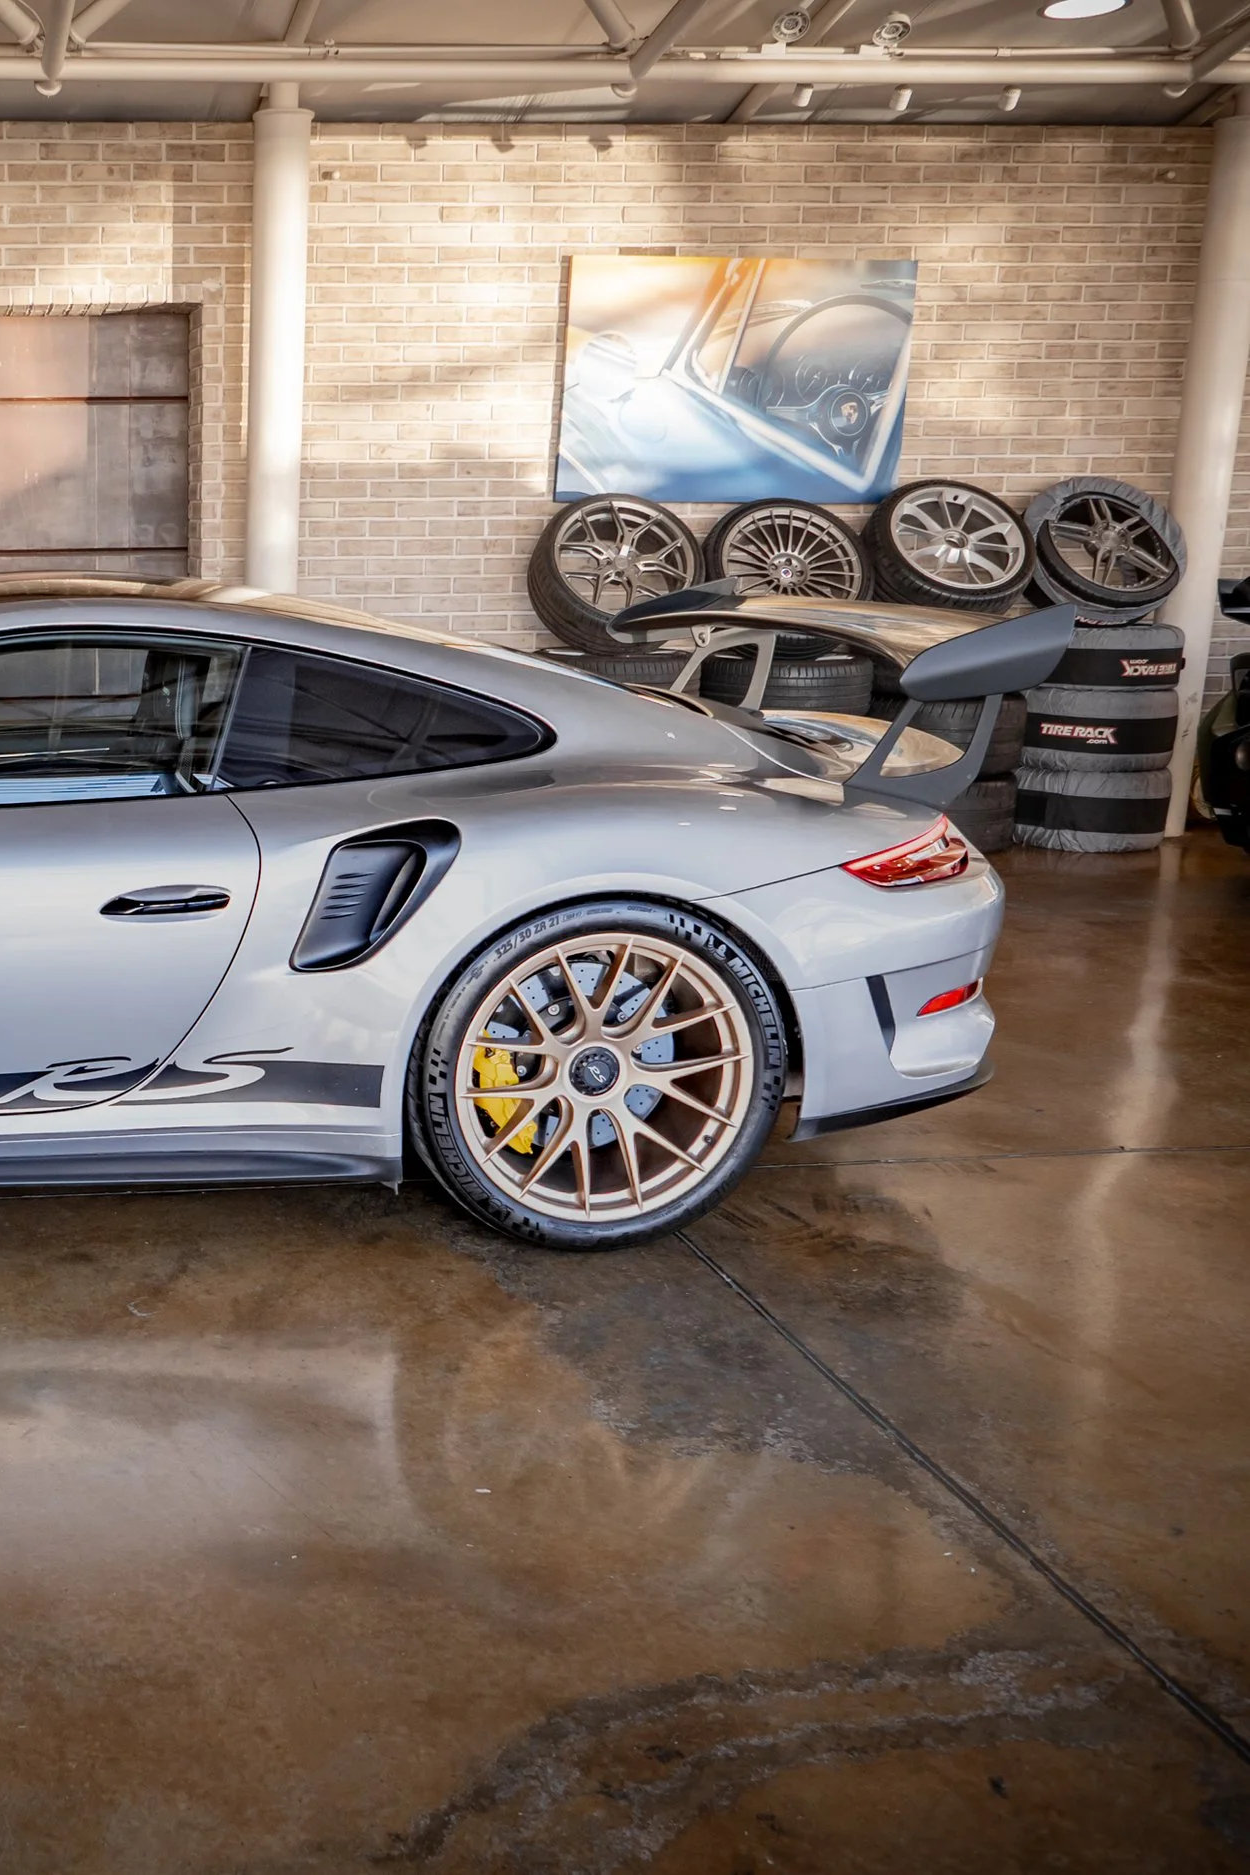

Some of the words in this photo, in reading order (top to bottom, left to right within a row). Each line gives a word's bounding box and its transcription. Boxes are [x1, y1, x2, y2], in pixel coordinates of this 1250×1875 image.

[1119, 660, 1157, 677] RACK
[1040, 723, 1074, 736] TIRE
[1073, 725, 1118, 744] RACK
[495, 929, 532, 959] 325/30
[533, 920, 547, 935] ZR
[549, 914, 560, 928] 21
[727, 956, 781, 1068] MICHELIN
[587, 1066, 607, 1083] RS
[428, 1092, 491, 1201] MICHELIN
